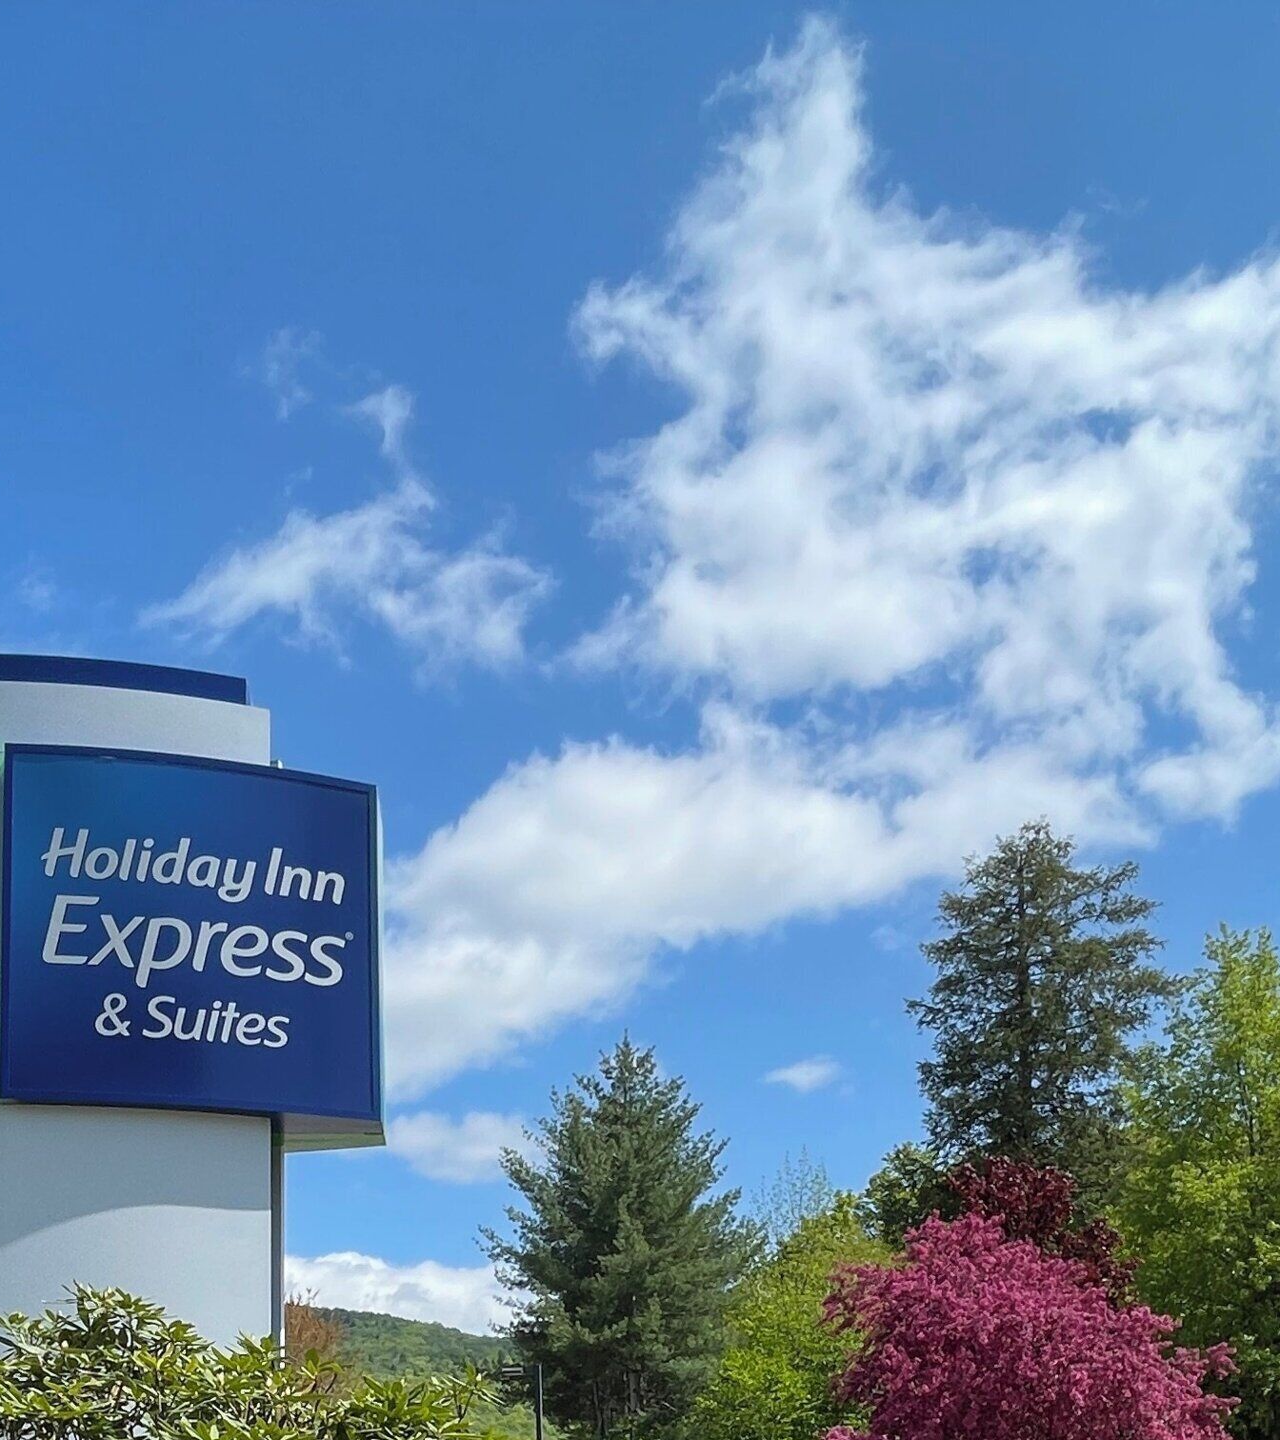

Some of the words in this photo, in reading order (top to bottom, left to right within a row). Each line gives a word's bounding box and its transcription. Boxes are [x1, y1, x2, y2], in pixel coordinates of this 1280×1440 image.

[41, 827, 257, 903] Holiday
[264, 847, 346, 905] Inn
[42, 894, 346, 989] Express
[94, 992, 131, 1037] &
[142, 994, 290, 1049] Suites
